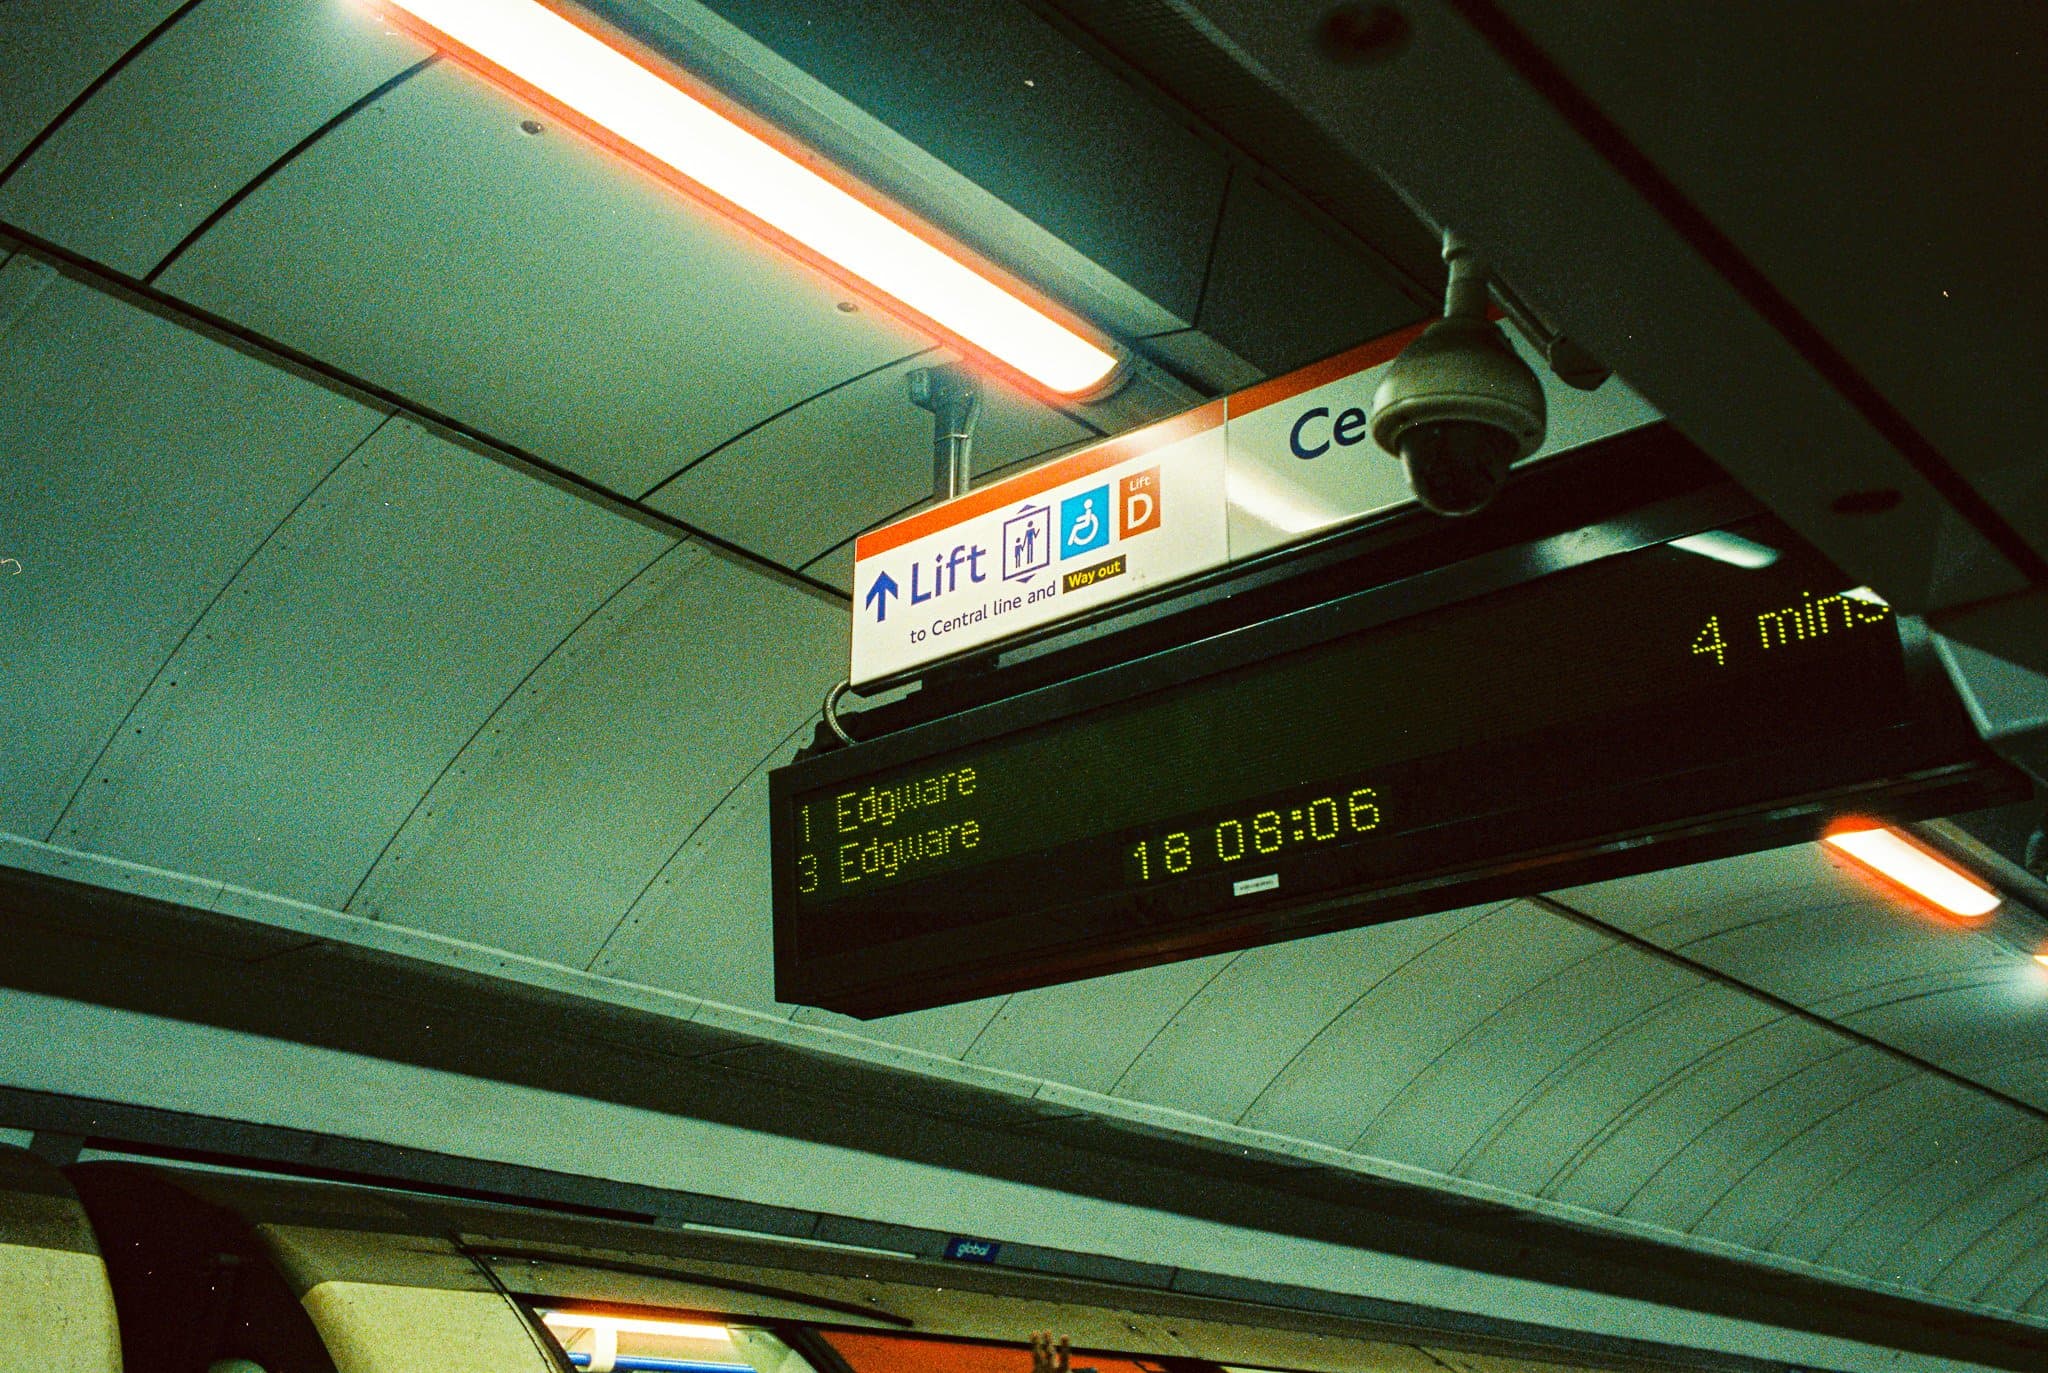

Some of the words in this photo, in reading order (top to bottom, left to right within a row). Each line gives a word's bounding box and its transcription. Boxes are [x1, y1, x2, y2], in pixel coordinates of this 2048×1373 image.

[1289, 406, 1370, 460] Ce
[1127, 492, 1153, 530] D
[1129, 476, 1151, 492] Lift
[910, 627, 927, 643] to
[931, 605, 988, 636] Central
[993, 595, 1022, 615] line
[1028, 581, 1057, 604] and
[1068, 571, 1095, 588] Way
[1098, 561, 1121, 578] out
[911, 545, 987, 605] Lift
[802, 805, 811, 843] 1
[836, 767, 976, 833] Edgware
[1692, 616, 1728, 666] 4
[1758, 586, 1889, 649] mins
[798, 854, 818, 893] 3
[839, 820, 980, 884] Edgware
